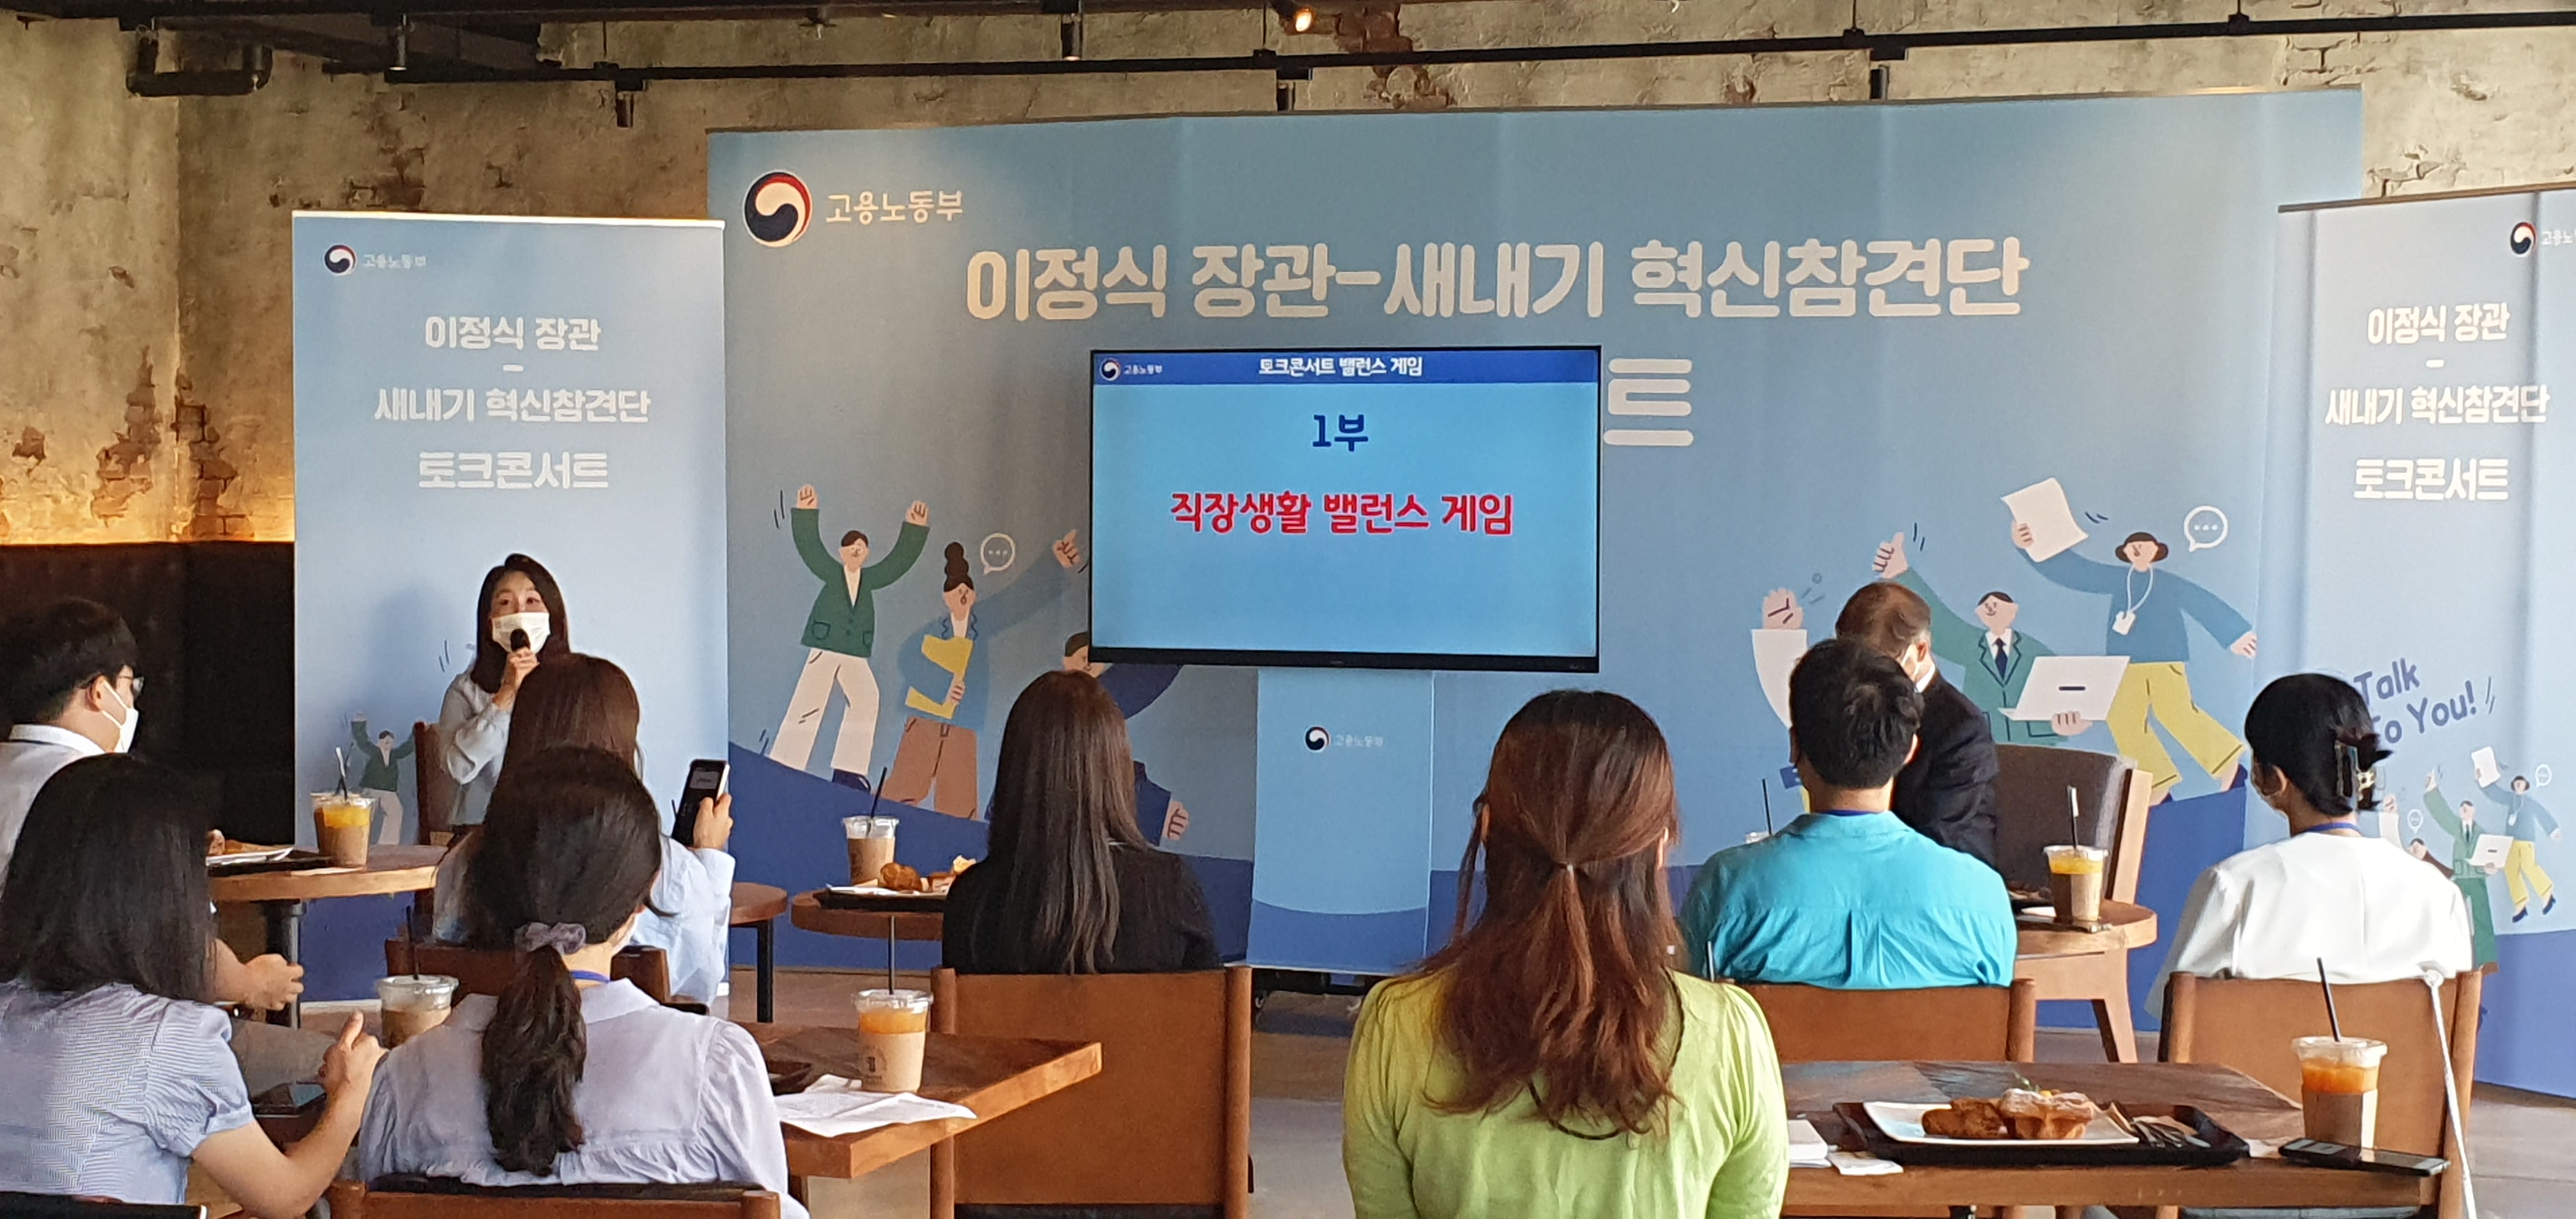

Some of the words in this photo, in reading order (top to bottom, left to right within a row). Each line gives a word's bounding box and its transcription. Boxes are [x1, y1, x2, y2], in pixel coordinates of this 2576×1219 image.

[826, 190, 963, 225] 고용노동부
[2542, 229, 2576, 246] 고용노
[966, 244, 1167, 321] 이정식
[1630, 236, 2030, 318] 혁신참견단
[424, 316, 525, 349] 이정식
[535, 318, 602, 351] 장관
[2367, 304, 2447, 344] 이정식
[2453, 302, 2510, 342] 장관
[1339, 356, 1387, 376] 밸런스
[1390, 356, 1423, 376] 게임
[374, 387, 476, 421] 새내기
[485, 388, 652, 422] 혁신참견단
[2325, 387, 2404, 425] 새내기
[2411, 384, 2551, 424] 혁신참견단
[1312, 414, 1369, 452] 1부
[418, 451, 610, 489] 토크콘서트
[2354, 457, 2509, 502] 토크콘서트
[1170, 491, 1312, 534] 직장생활
[1323, 493, 1430, 534] 밸런스
[1441, 493, 1514, 535] 게임
[2353, 657, 2420, 705] Talk
[2406, 679, 2476, 734] You!
